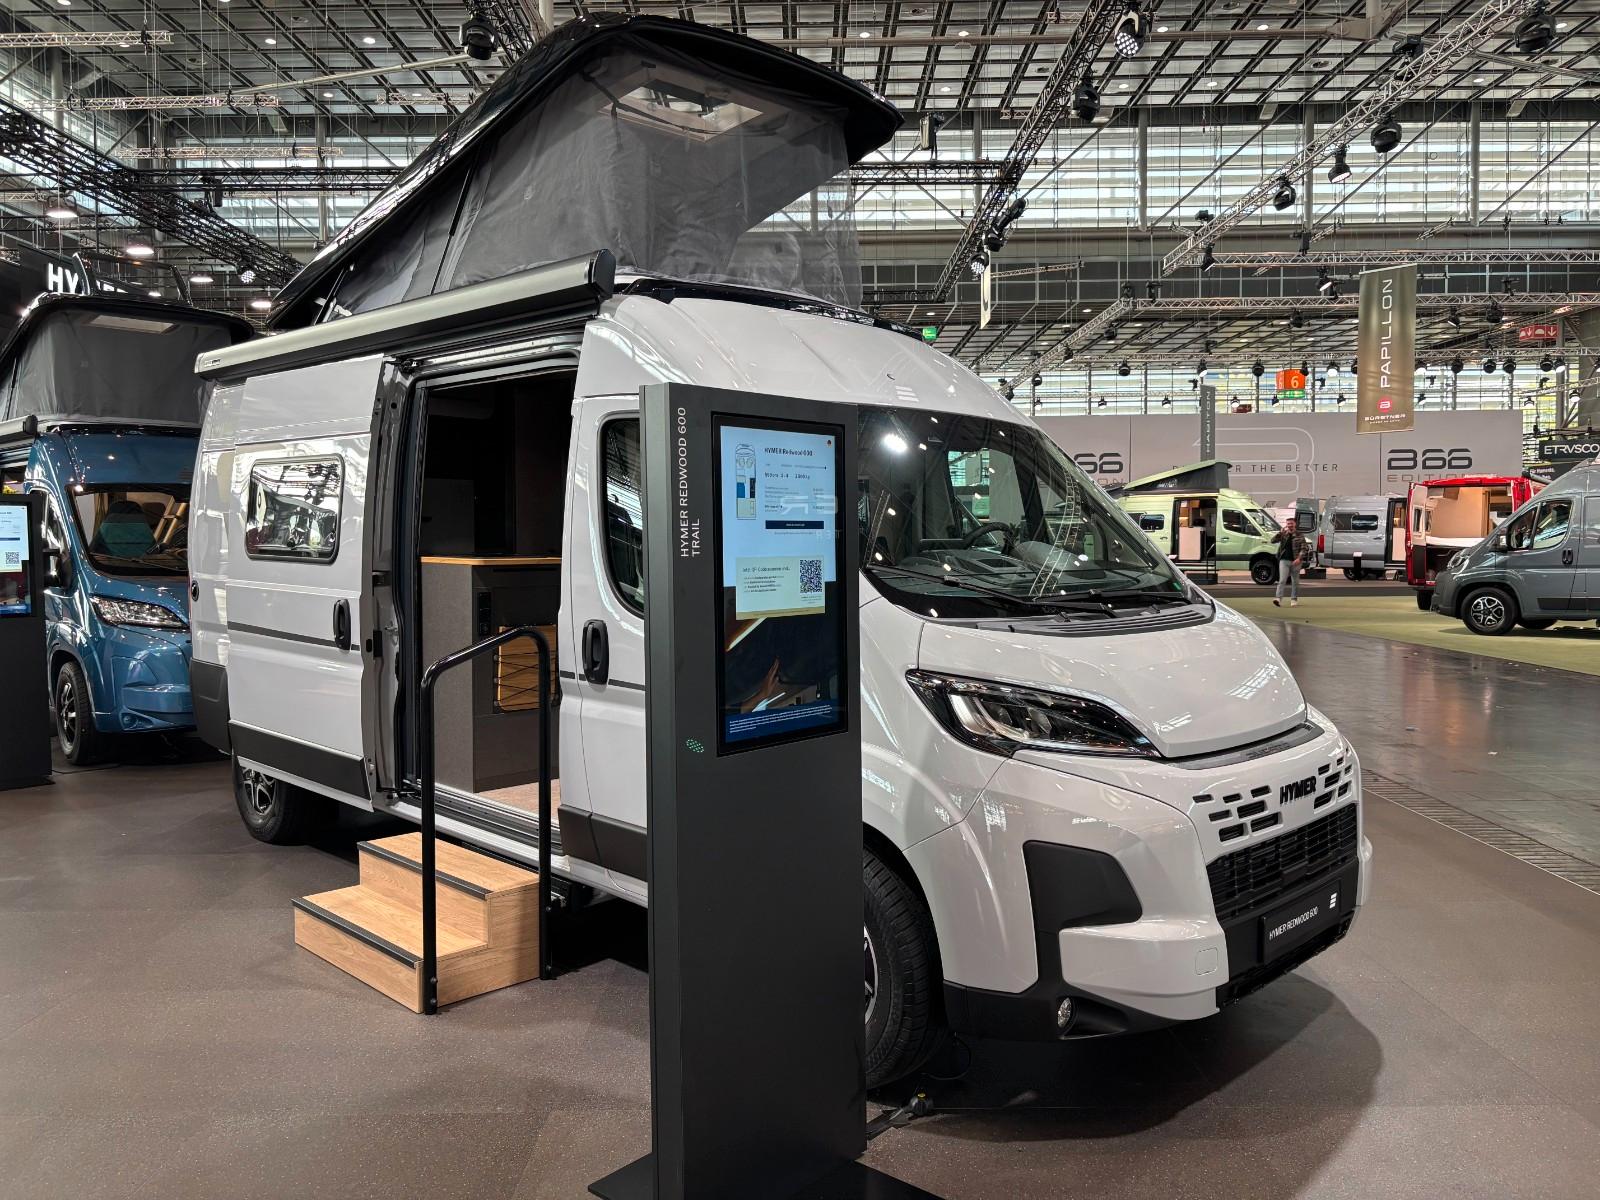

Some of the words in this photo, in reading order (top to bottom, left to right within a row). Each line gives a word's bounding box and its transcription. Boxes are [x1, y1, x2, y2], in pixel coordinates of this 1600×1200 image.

[1380, 278, 1393, 388] PAPILLON
[1290, 375, 1300, 389] 6
[677, 407, 687, 434] 600
[678, 437, 688, 507] REDWOOD
[1073, 452, 1124, 474] 66
[1251, 464, 1276, 473] THE
[1285, 463, 1339, 472] BETTER
[1387, 473, 1466, 482] EDITIO
[680, 510, 689, 557] HYMER
[691, 518, 700, 557] TRAIL
[1279, 775, 1317, 805] HYMER
[1269, 923, 1287, 941] HYMER
[1286, 911, 1310, 930] REDWOOD
[1309, 906, 1319, 918] 600
